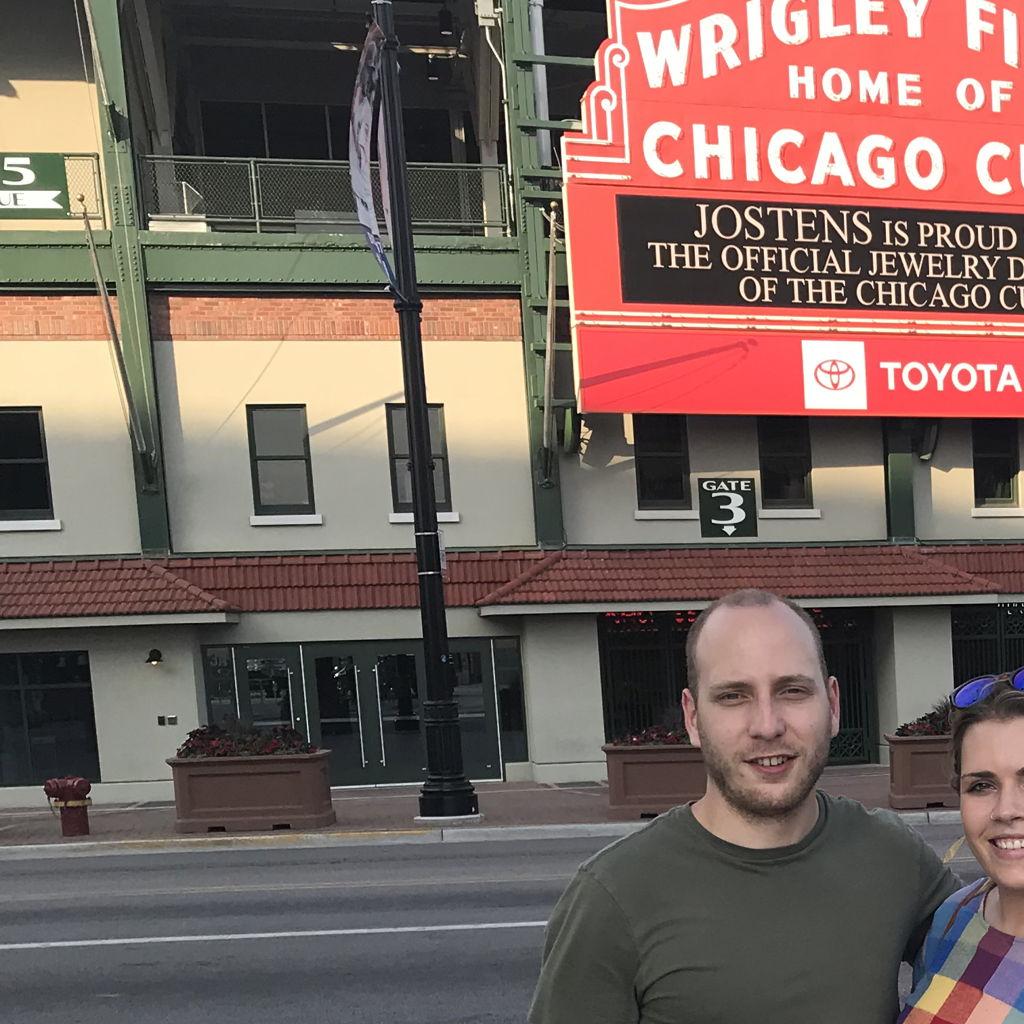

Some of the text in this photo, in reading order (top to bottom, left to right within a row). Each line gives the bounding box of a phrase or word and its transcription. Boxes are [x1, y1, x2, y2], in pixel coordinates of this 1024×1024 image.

[637, 0, 929, 89] WRIGLEY
[789, 65, 1013, 112] HOME OF
[3, 157, 35, 185] 5
[642, 121, 944, 191] CHICAGO
[694, 204, 873, 245] JOSTENS
[883, 220, 909, 247] IS
[917, 222, 1018, 250] PROUD
[648, 242, 713, 269] THE
[721, 245, 861, 275] OFFICIAL
[868, 250, 1001, 280] JEWELRY
[739, 276, 778, 302] OF
[787, 278, 848, 304] THE
[856, 280, 991, 310] CHICAGO
[879, 361, 1022, 392] TOYOTA
[702, 480, 751, 491] GATE
[711, 492, 746, 525] 3
